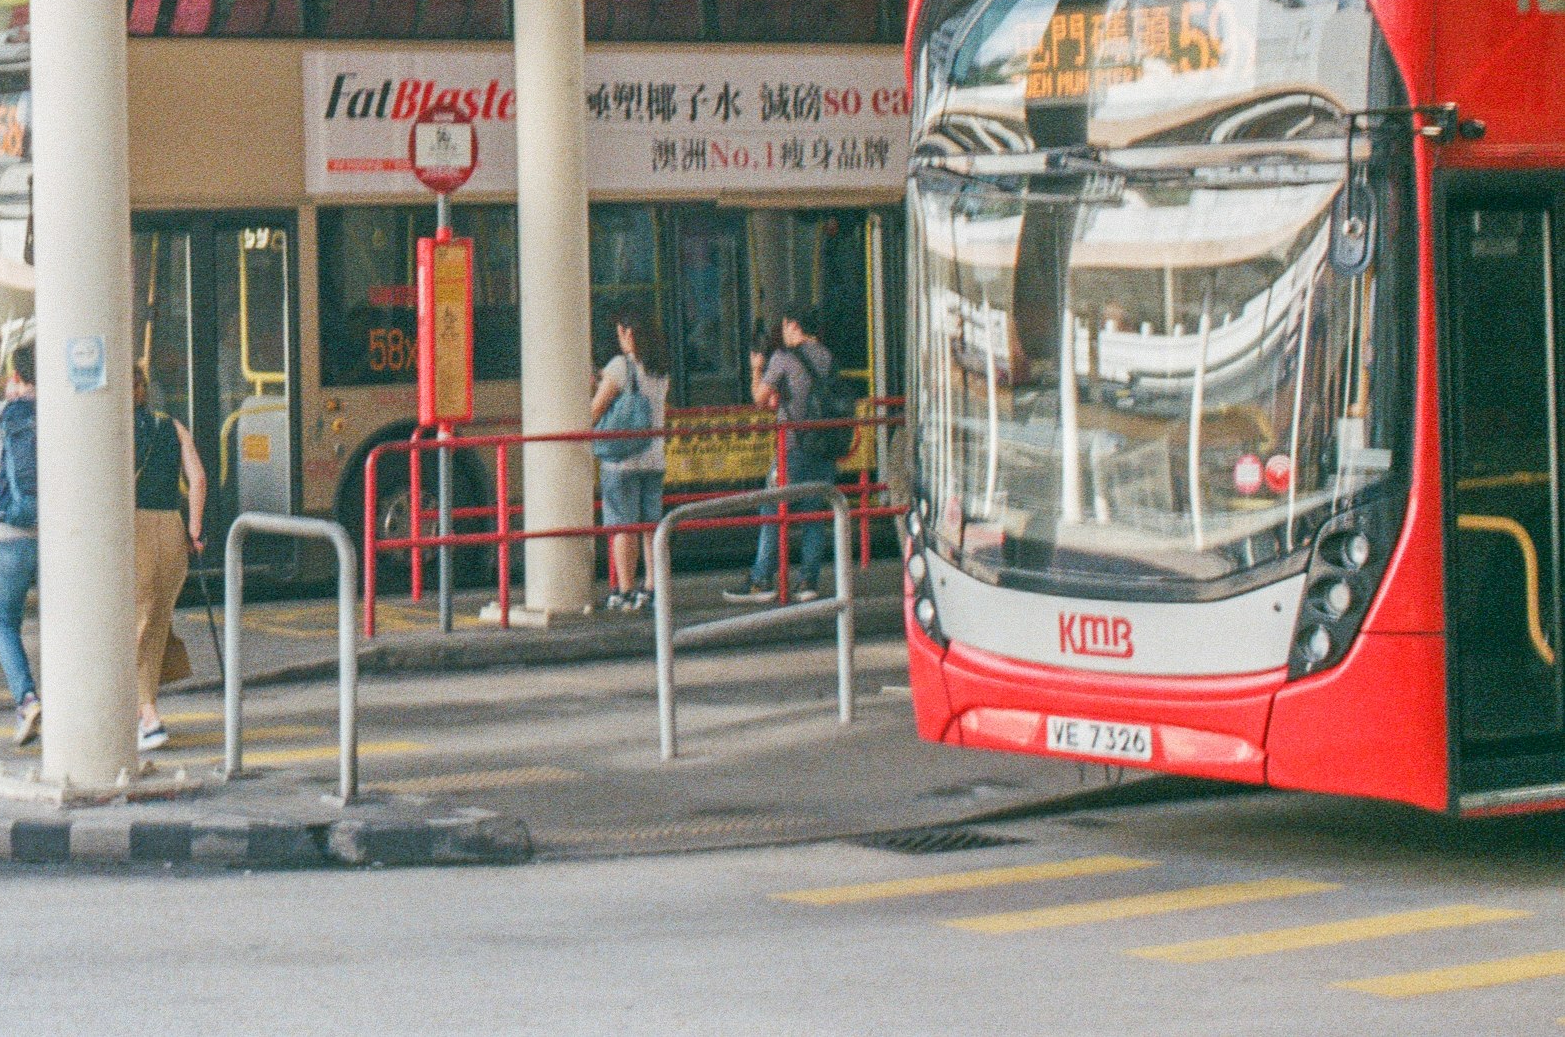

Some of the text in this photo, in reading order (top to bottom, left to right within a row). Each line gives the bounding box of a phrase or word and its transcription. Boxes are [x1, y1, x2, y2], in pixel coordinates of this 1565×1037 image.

[1058, 611, 1134, 659] KMB
[1053, 719, 1147, 754] VE 7326
